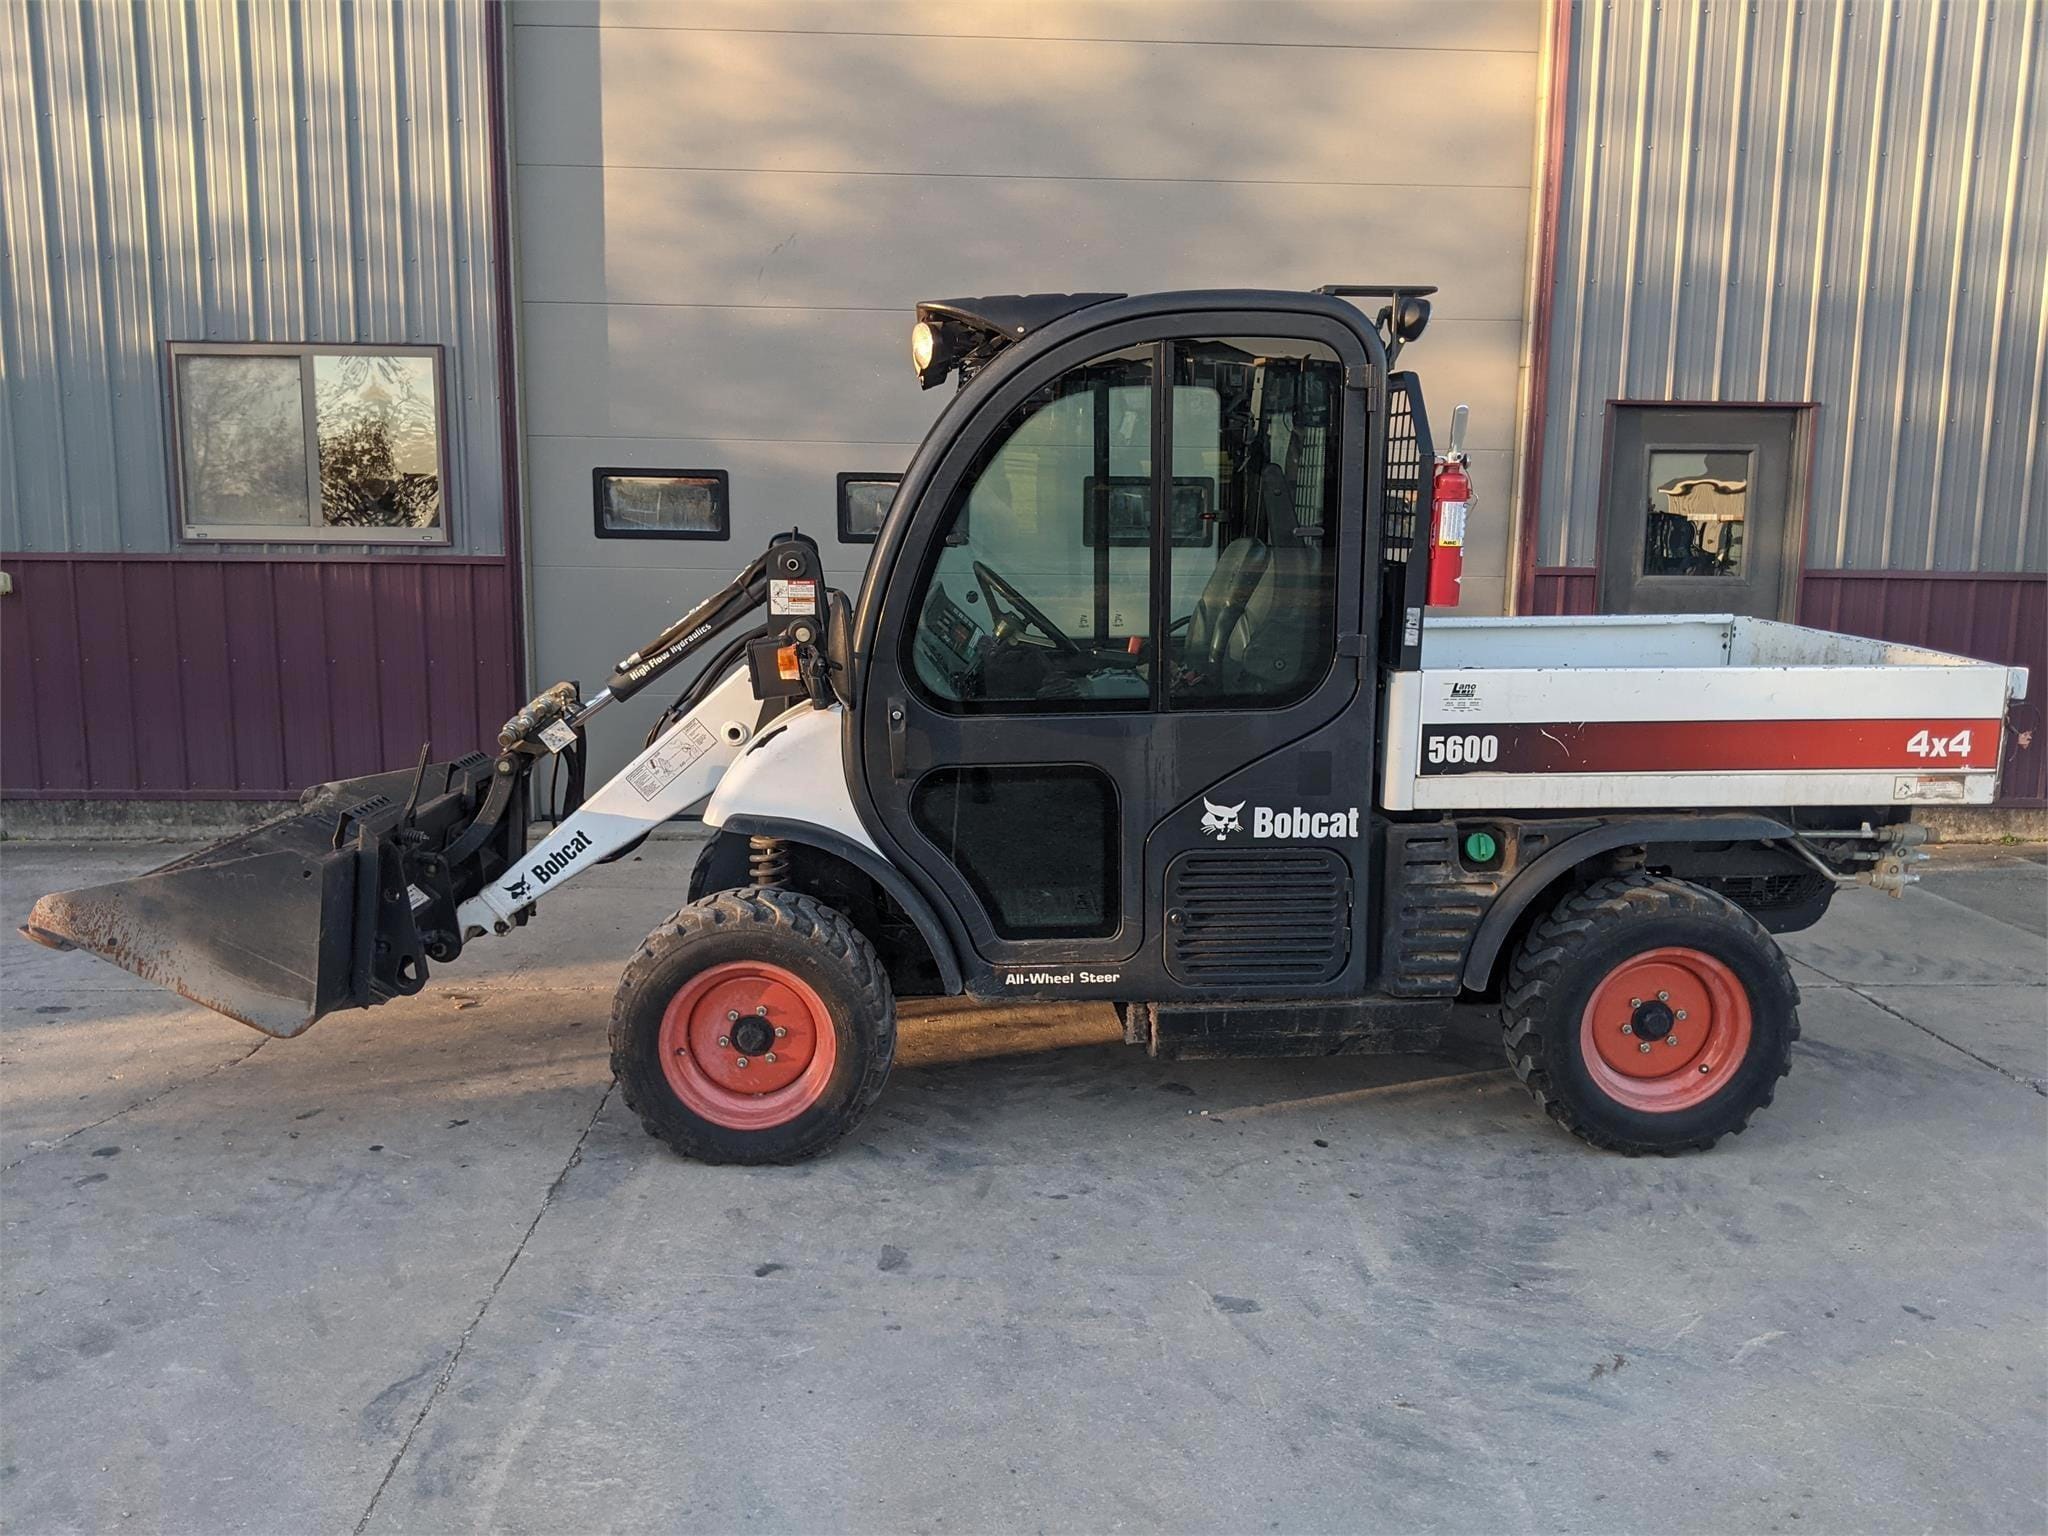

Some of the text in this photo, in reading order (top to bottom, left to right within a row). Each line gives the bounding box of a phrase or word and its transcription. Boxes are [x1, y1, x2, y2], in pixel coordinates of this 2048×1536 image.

[629, 623, 712, 681] High Flow Hydraulics
[1428, 735, 1498, 763] 5600
[1906, 730, 1972, 758] 4x4
[1253, 807, 1359, 838] Bobcat
[530, 830, 593, 885] Bobcat
[1005, 971, 1121, 985] All-Wheel Steer
